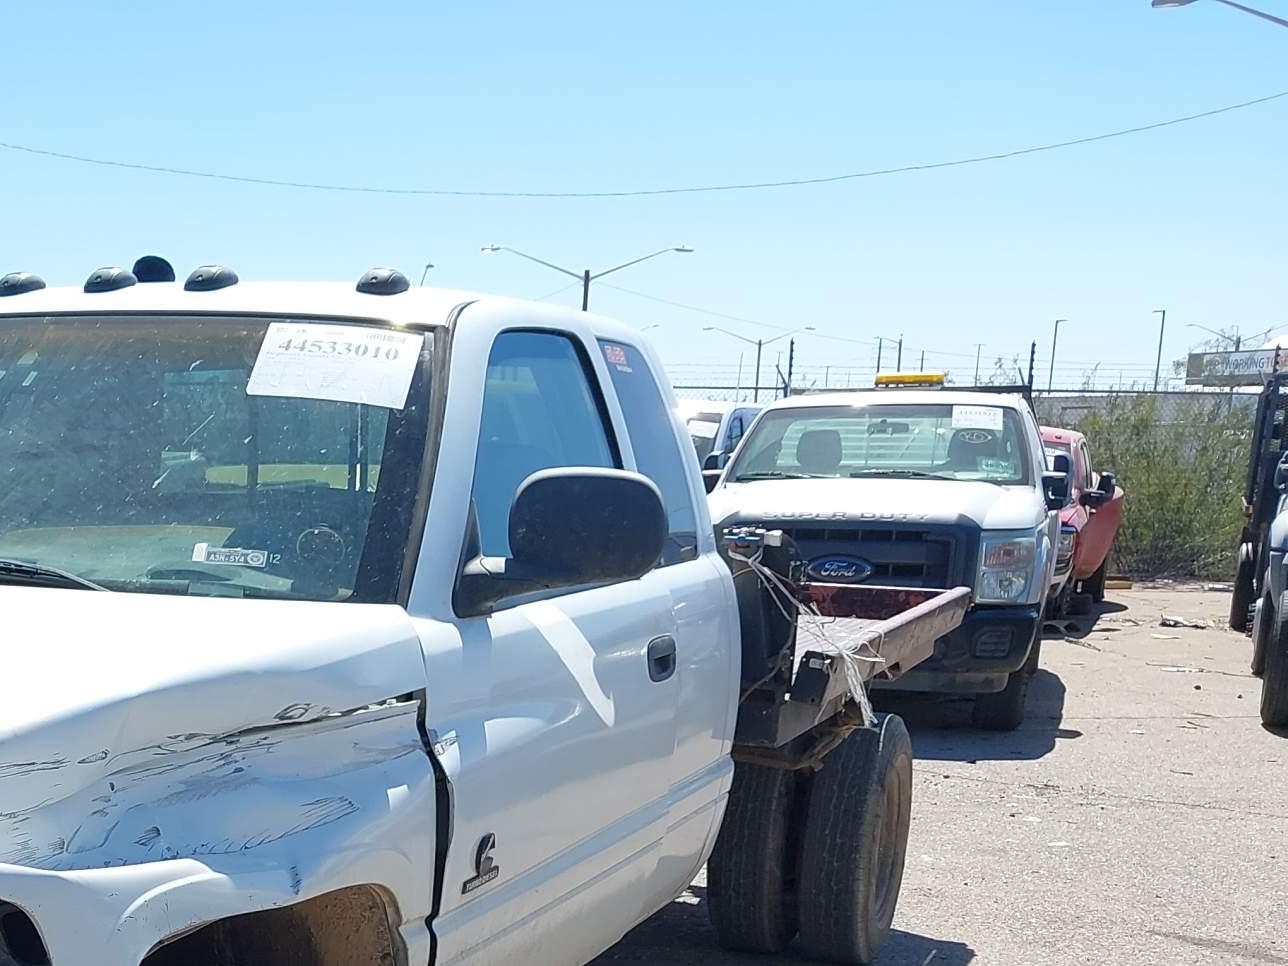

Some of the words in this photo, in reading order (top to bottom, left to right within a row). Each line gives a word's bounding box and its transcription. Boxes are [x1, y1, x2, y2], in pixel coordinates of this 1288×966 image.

[278, 338, 399, 361] 44533010
[760, 510, 848, 521] SUPER
[859, 510, 929, 521] DUTY
[269, 553, 281, 564] 12
[819, 561, 857, 577] Ford
